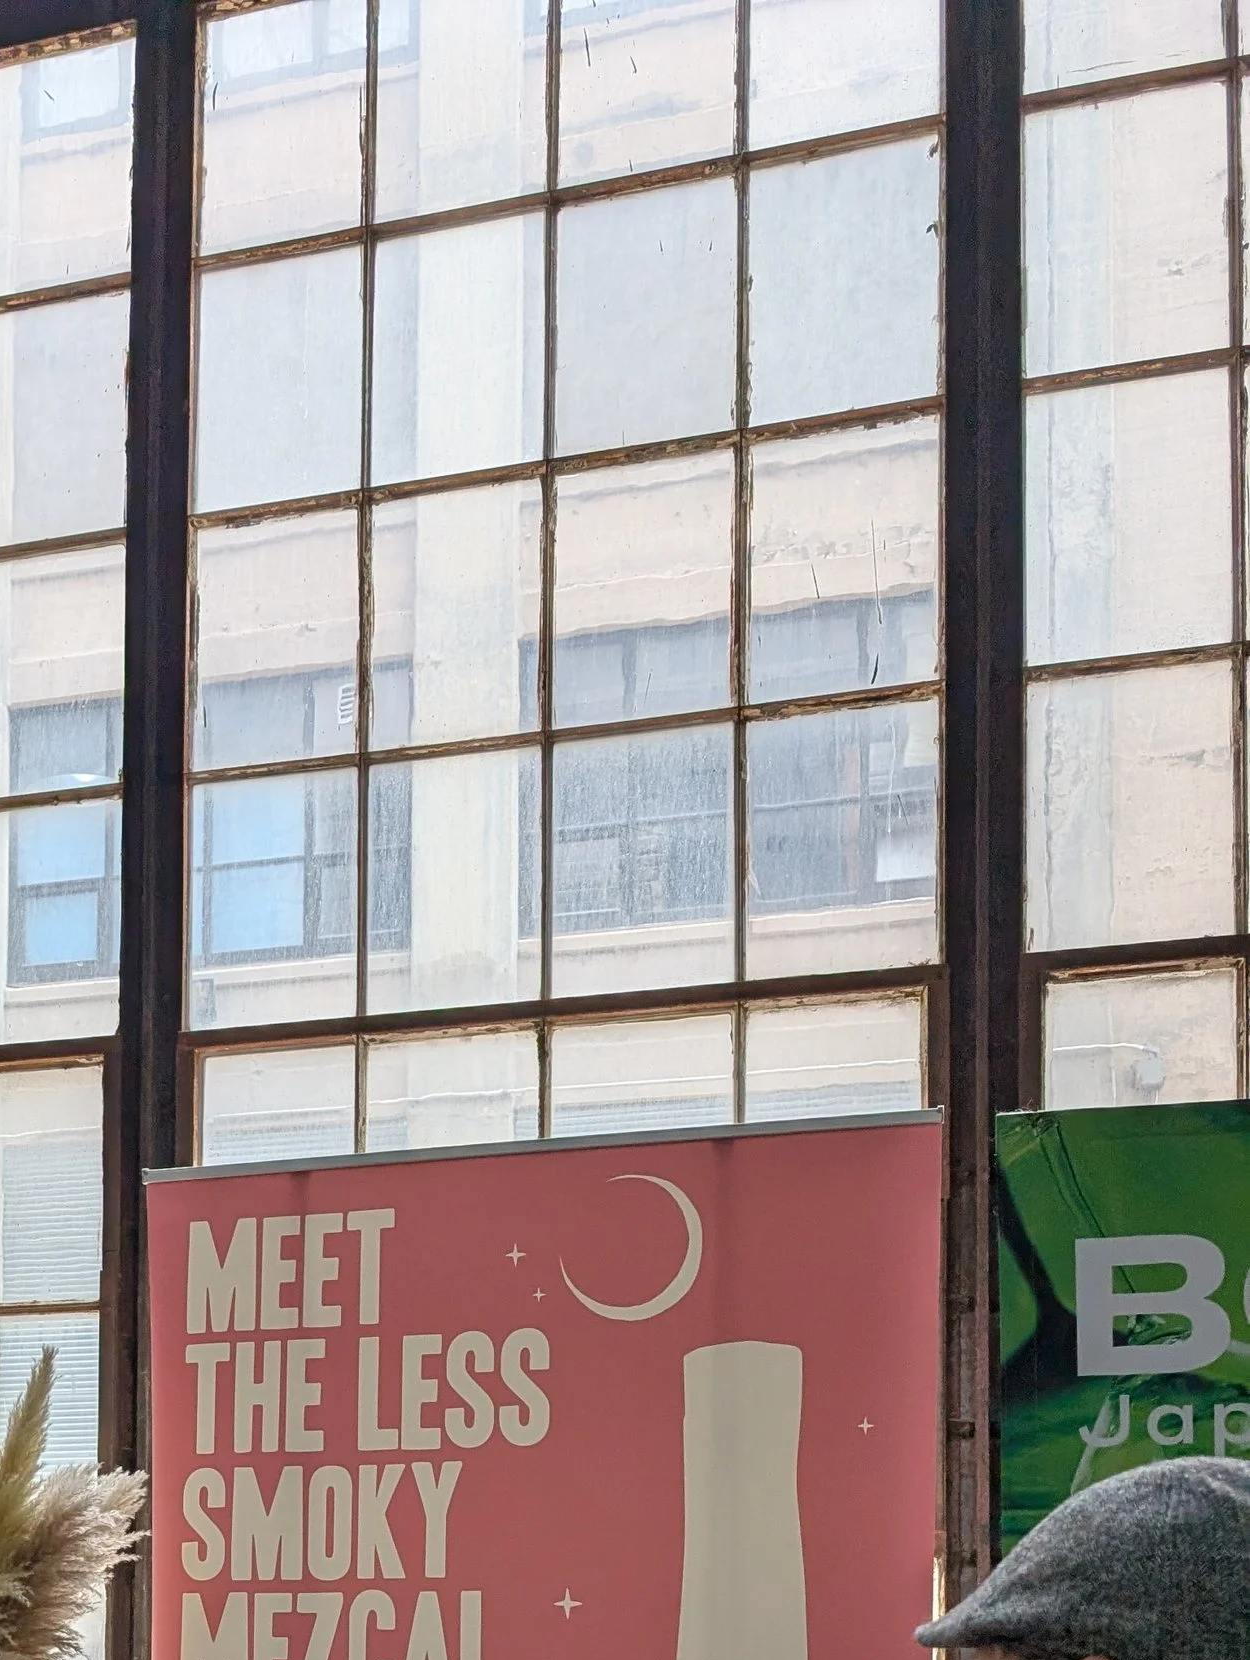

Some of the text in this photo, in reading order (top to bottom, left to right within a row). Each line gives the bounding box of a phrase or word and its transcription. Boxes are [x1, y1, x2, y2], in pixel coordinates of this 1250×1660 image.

[186, 1207, 395, 1334] MEET
[1075, 1234, 1250, 1377] B
[185, 1327, 551, 1454] THE LESS
[181, 1461, 463, 1582] SMOKY
